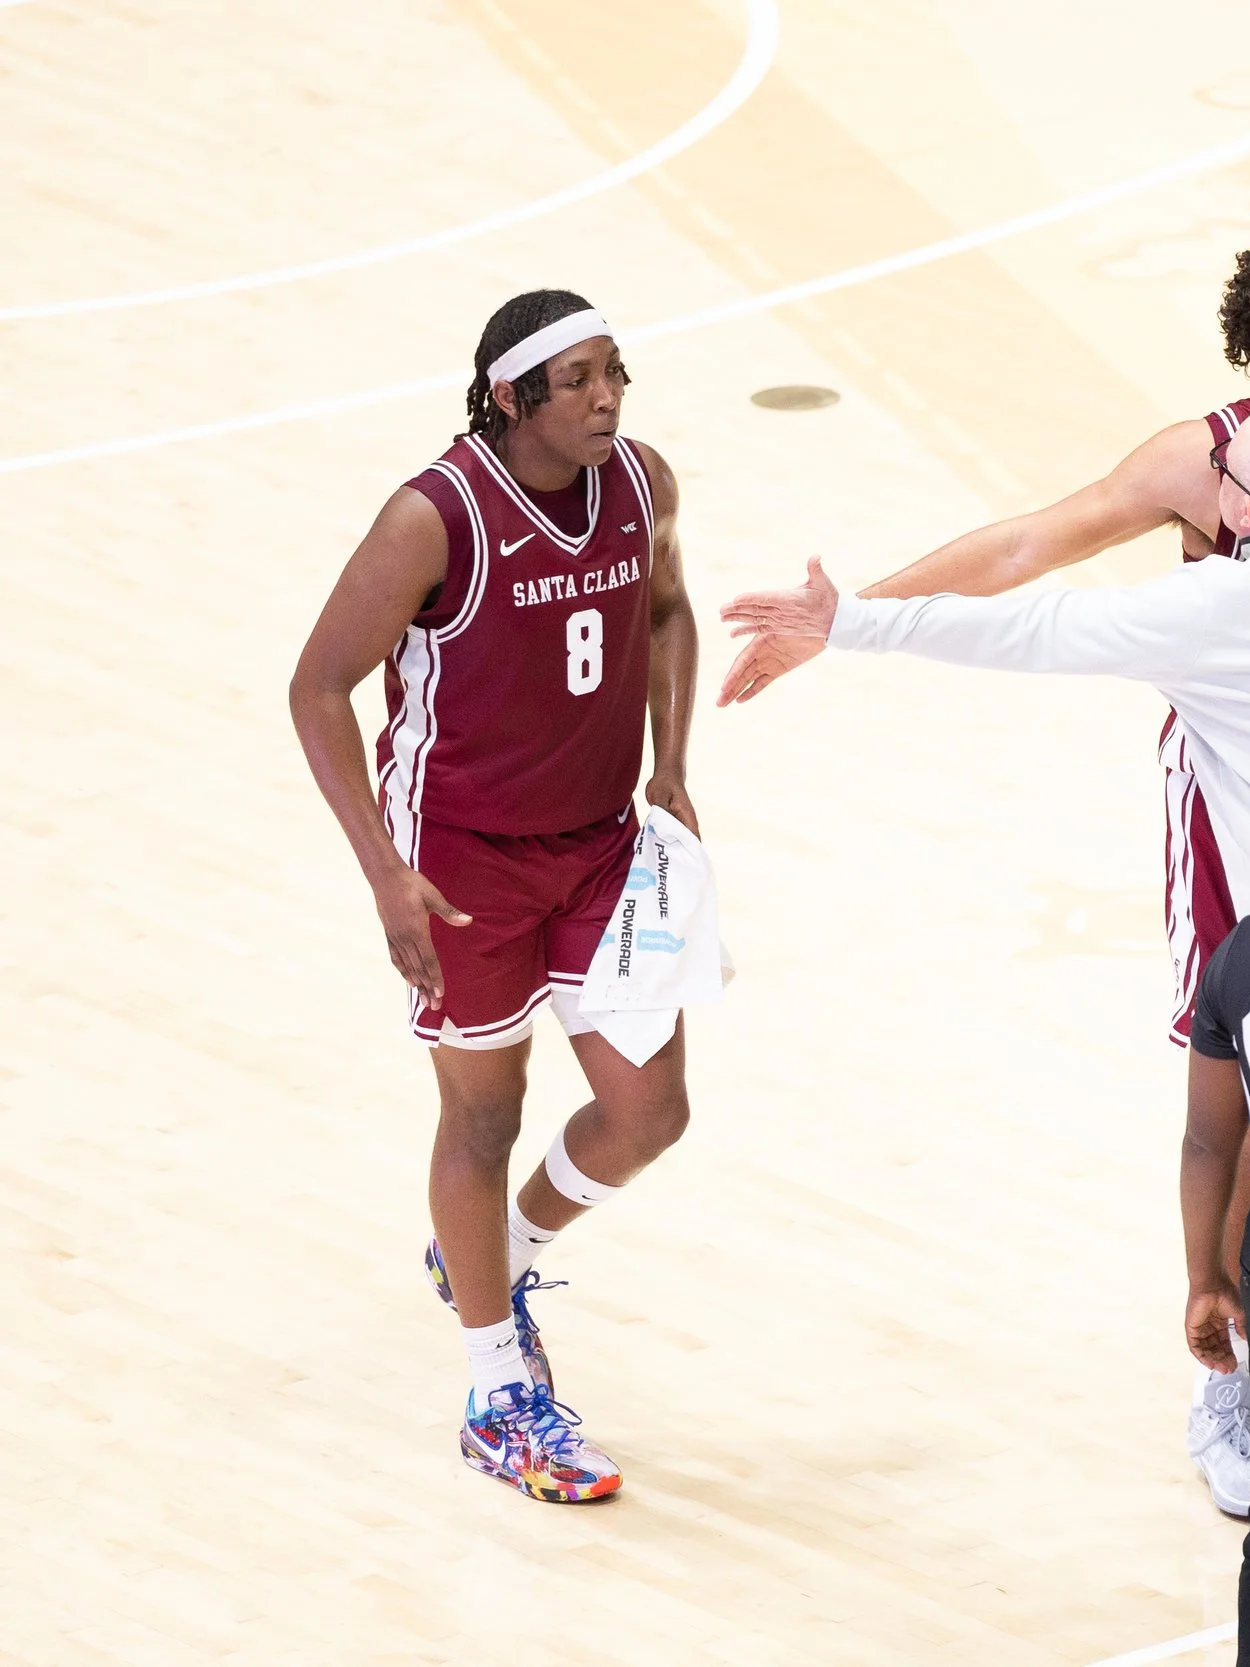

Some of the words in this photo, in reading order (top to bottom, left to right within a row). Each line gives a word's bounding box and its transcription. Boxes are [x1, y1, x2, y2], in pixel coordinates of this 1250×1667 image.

[513, 574, 578, 607] SANTA
[583, 556, 640, 594] CLARA
[566, 608, 603, 697] 8
[618, 899, 636, 978] POWERADE
